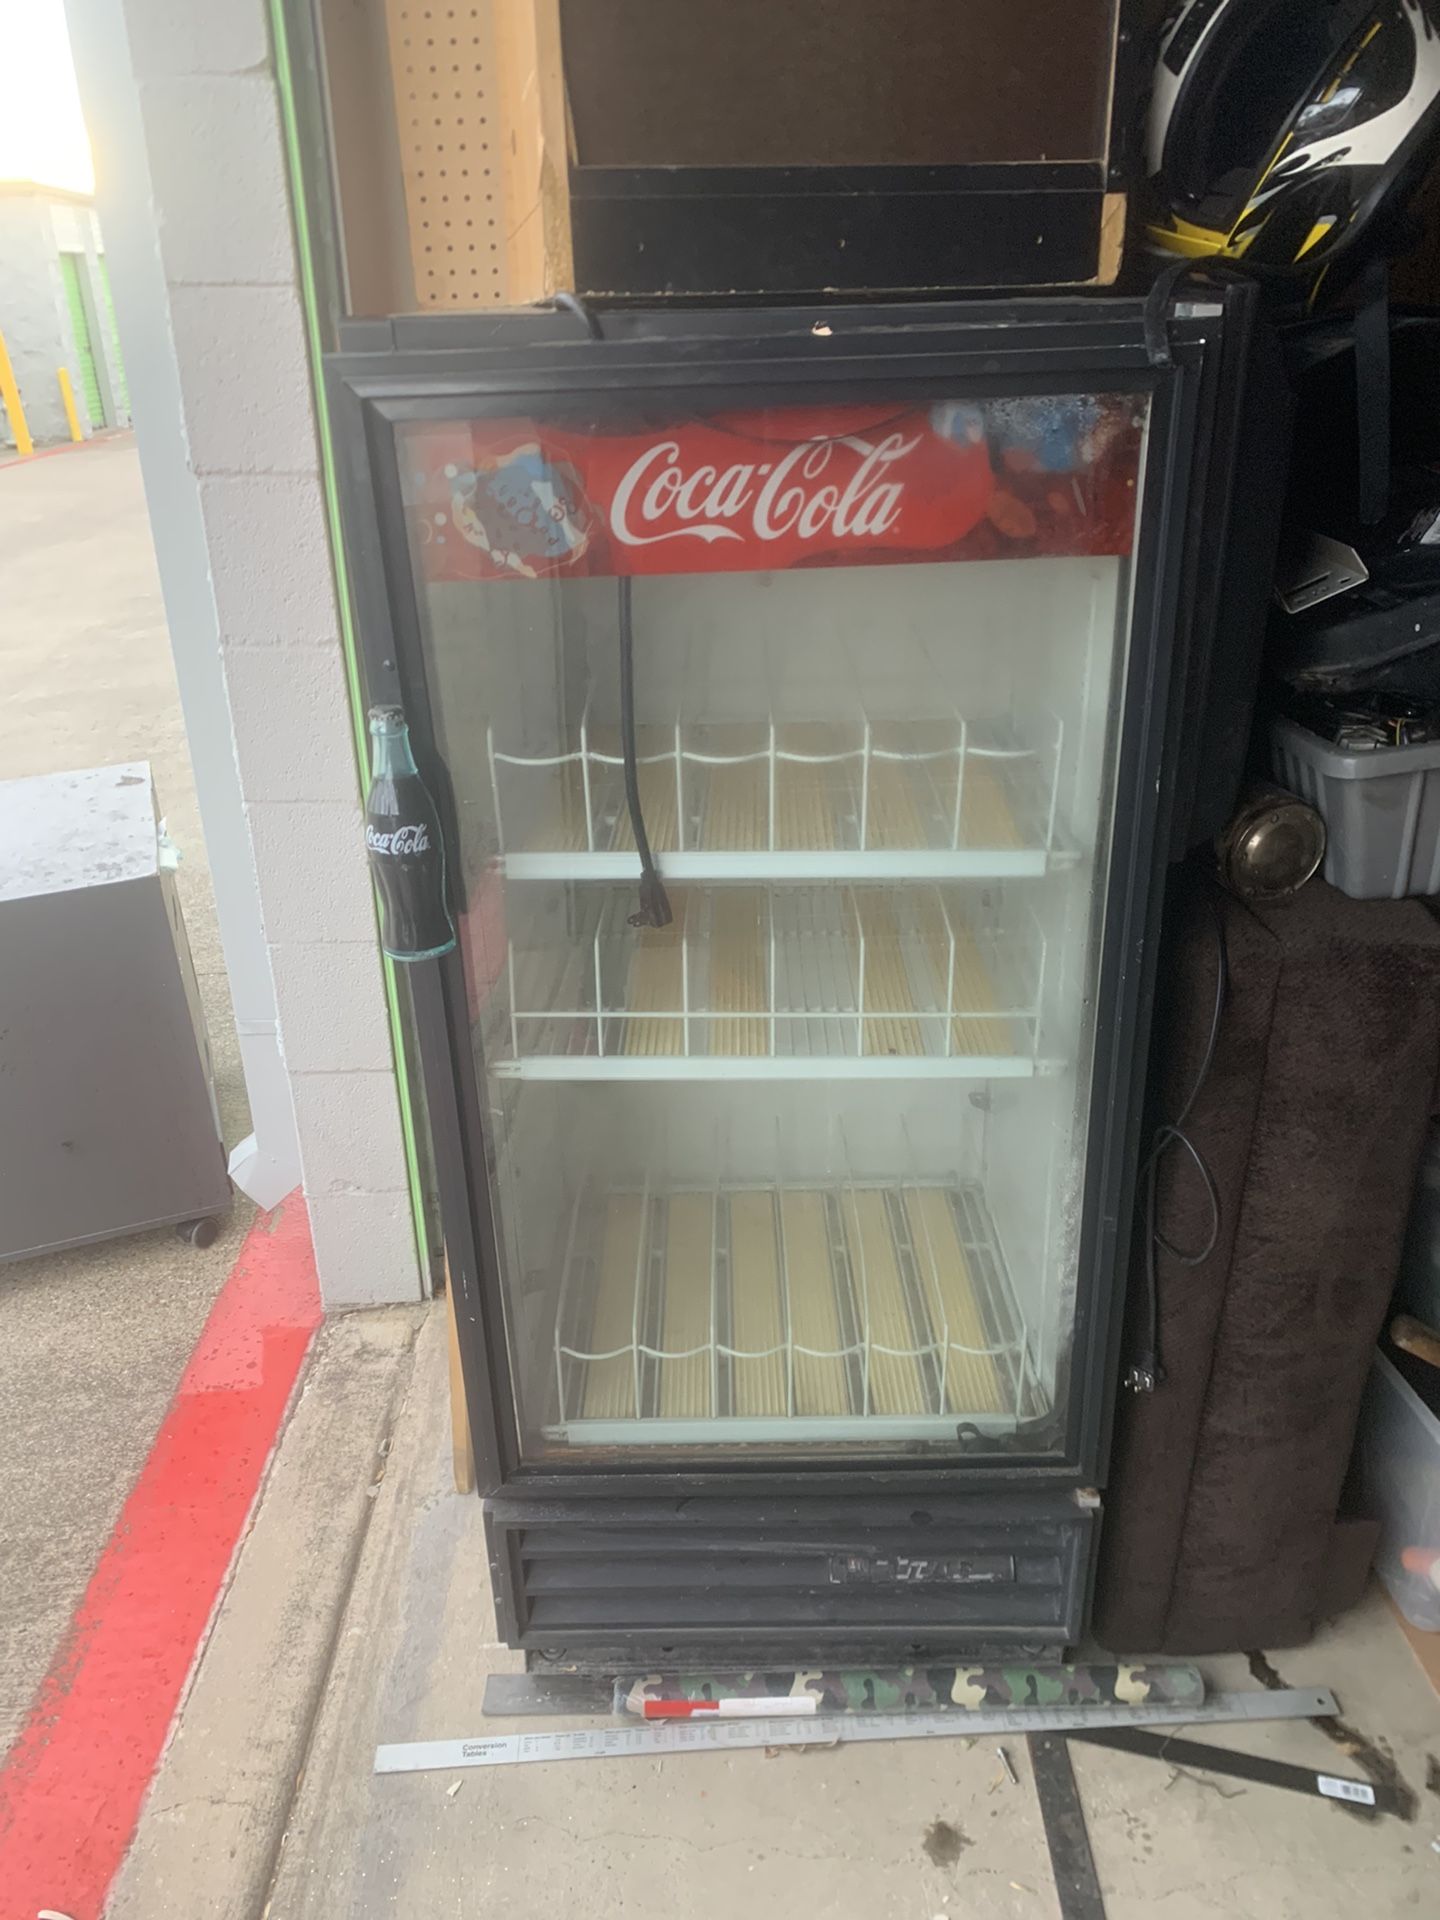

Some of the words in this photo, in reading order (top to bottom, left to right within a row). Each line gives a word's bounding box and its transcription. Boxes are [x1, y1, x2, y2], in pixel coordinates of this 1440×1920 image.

[610, 433, 923, 545] Coca-Cola
[366, 824, 430, 855] Coca-Cola
[462, 1742, 507, 1751] Conversion
[462, 1750, 487, 1758] Tables
